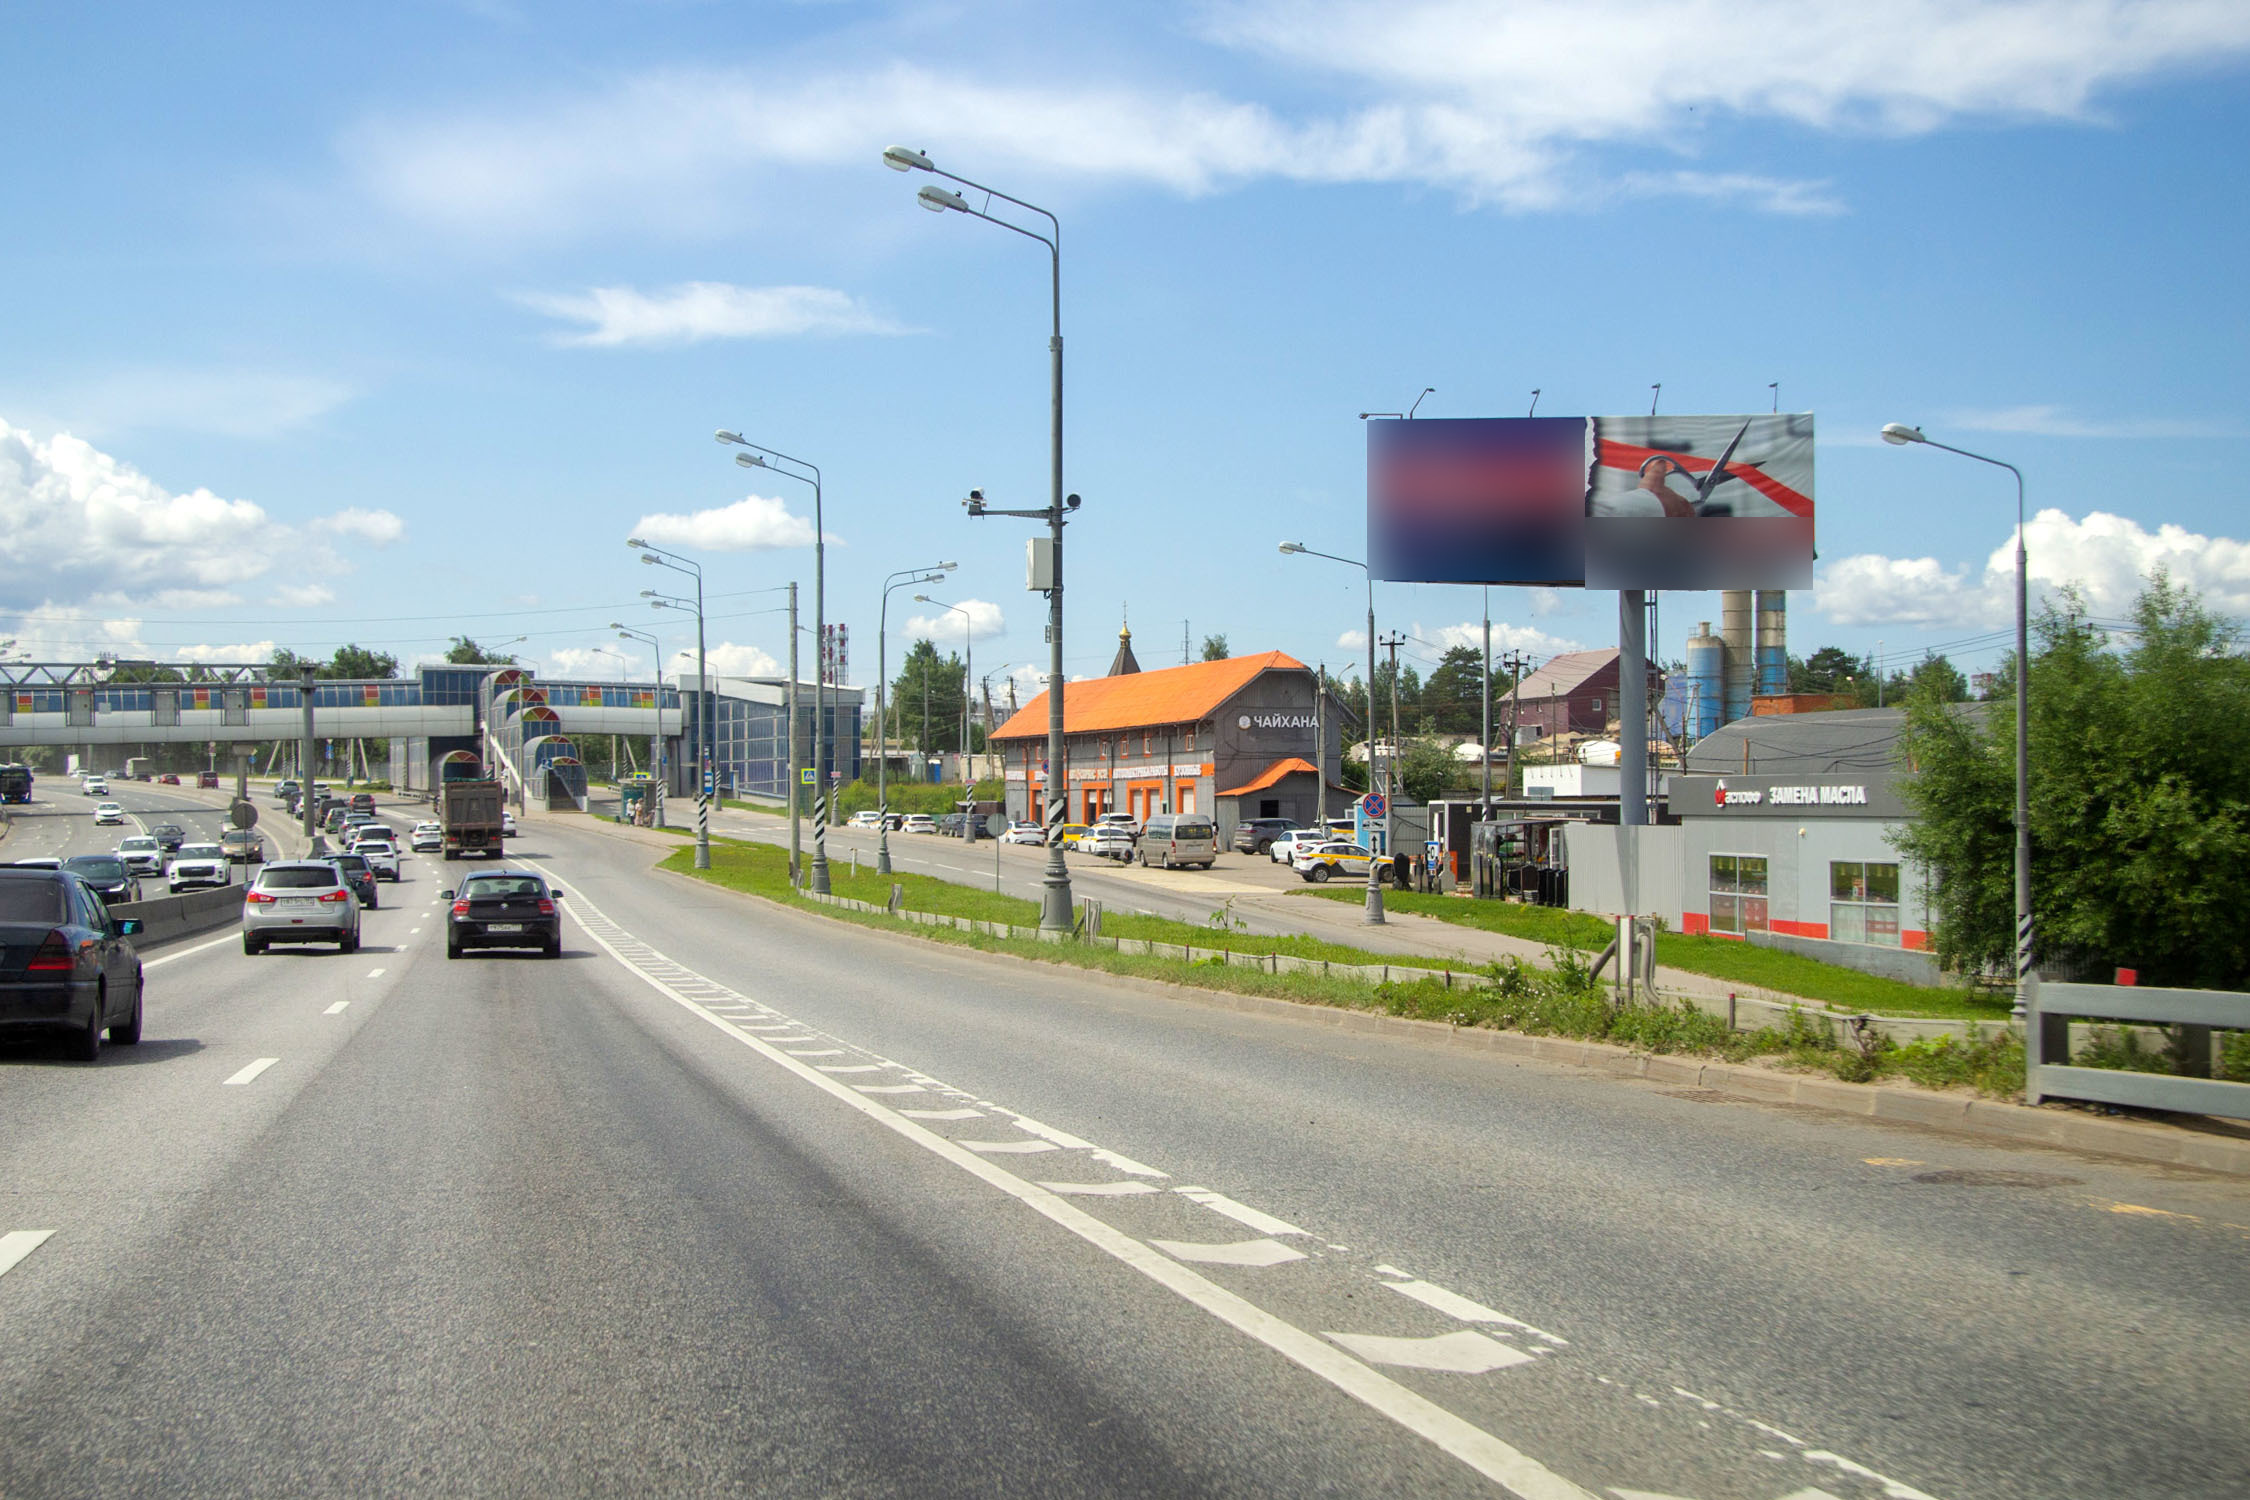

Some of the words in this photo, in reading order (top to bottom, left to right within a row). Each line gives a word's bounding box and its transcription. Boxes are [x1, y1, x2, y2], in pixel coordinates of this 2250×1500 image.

[1254, 713, 1320, 728] ЧАЙХАНА
[1769, 786, 1819, 804] ЗАМЕНА
[1820, 786, 1867, 804] МАСЛА
